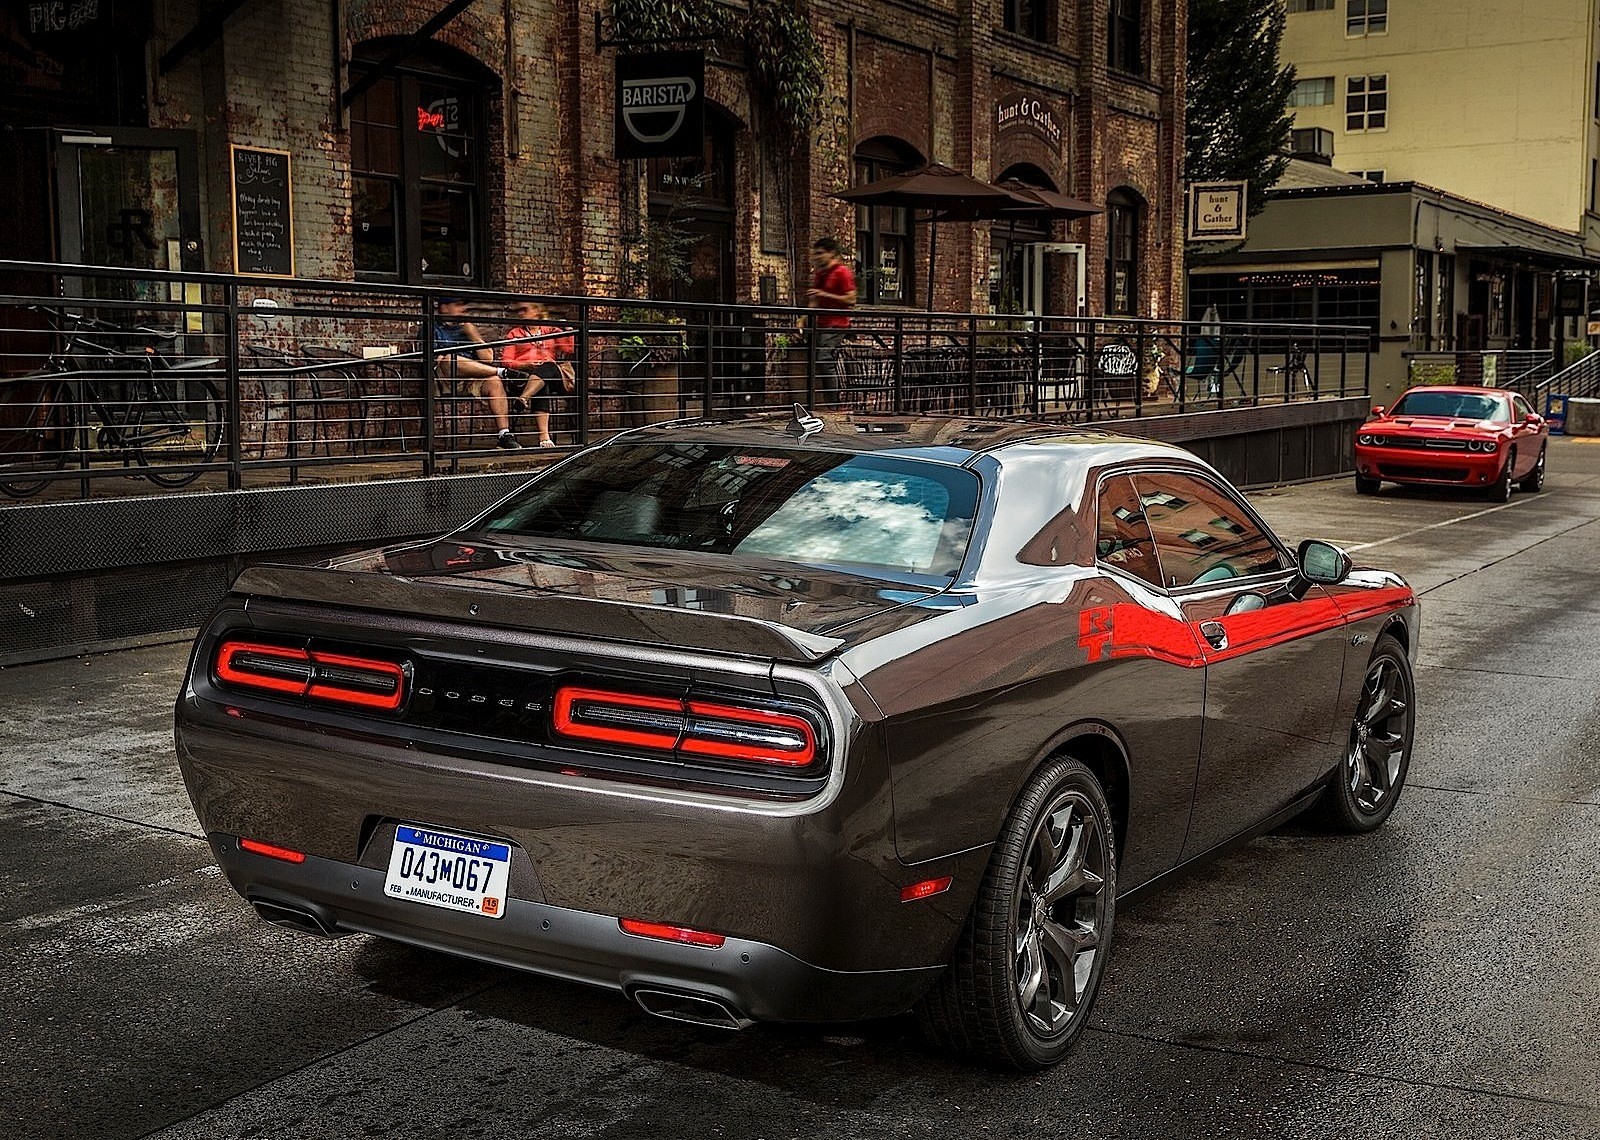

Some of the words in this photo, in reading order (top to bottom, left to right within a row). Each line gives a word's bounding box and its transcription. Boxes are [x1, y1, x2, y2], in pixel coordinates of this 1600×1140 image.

[29, 2, 66, 33] PIG
[622, 85, 686, 106] BARISTA
[998, 104, 1018, 124] hunt
[1020, 97, 1029, 116] &
[1031, 100, 1061, 140] Gather
[1209, 195, 1228, 203] hunt
[1214, 204, 1222, 213] &
[1203, 214, 1232, 223] Gather
[418, 687, 542, 711] DODGE
[422, 832, 481, 855] MICHIGAN
[400, 847, 494, 893] 043M067
[390, 884, 402, 893] FEB
[409, 887, 475, 908] MANUFACTURER
[486, 899, 498, 908] 15
